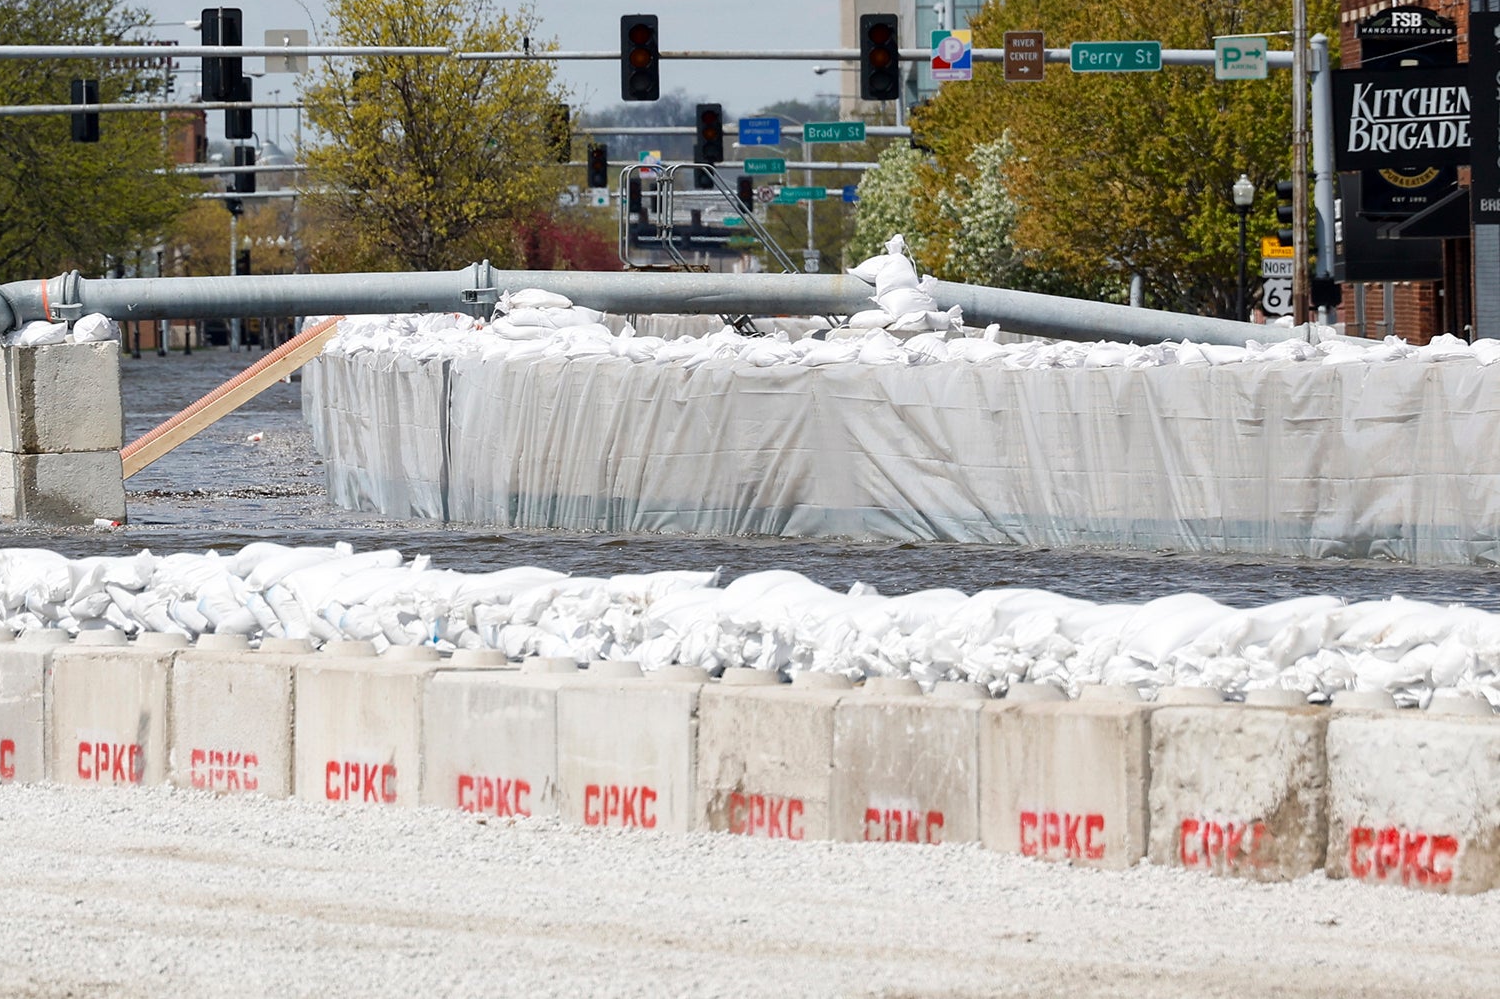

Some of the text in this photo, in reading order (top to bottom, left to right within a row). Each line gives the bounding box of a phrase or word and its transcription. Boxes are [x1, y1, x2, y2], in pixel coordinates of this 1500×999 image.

[1391, 12, 1422, 27] FSB
[1009, 52, 1038, 61] CENTER
[1012, 38, 1035, 48] RIVER
[1078, 49, 1153, 67] Perry St
[1351, 83, 1471, 123] KITCHEN
[808, 126, 860, 140] Brady St
[1347, 118, 1471, 153] BRIGADE
[1264, 262, 1293, 274] NORT
[1267, 286, 1294, 308] 67
[78, 742, 145, 782] CPKC
[192, 750, 258, 790] CPKC
[326, 761, 397, 802] CPKC
[458, 775, 531, 817] CPKC
[585, 785, 657, 828] CPKC
[731, 795, 804, 840] CPKC
[865, 809, 945, 844] CPKC
[1020, 812, 1105, 859] CPKC
[1351, 827, 1459, 885] CPKC
